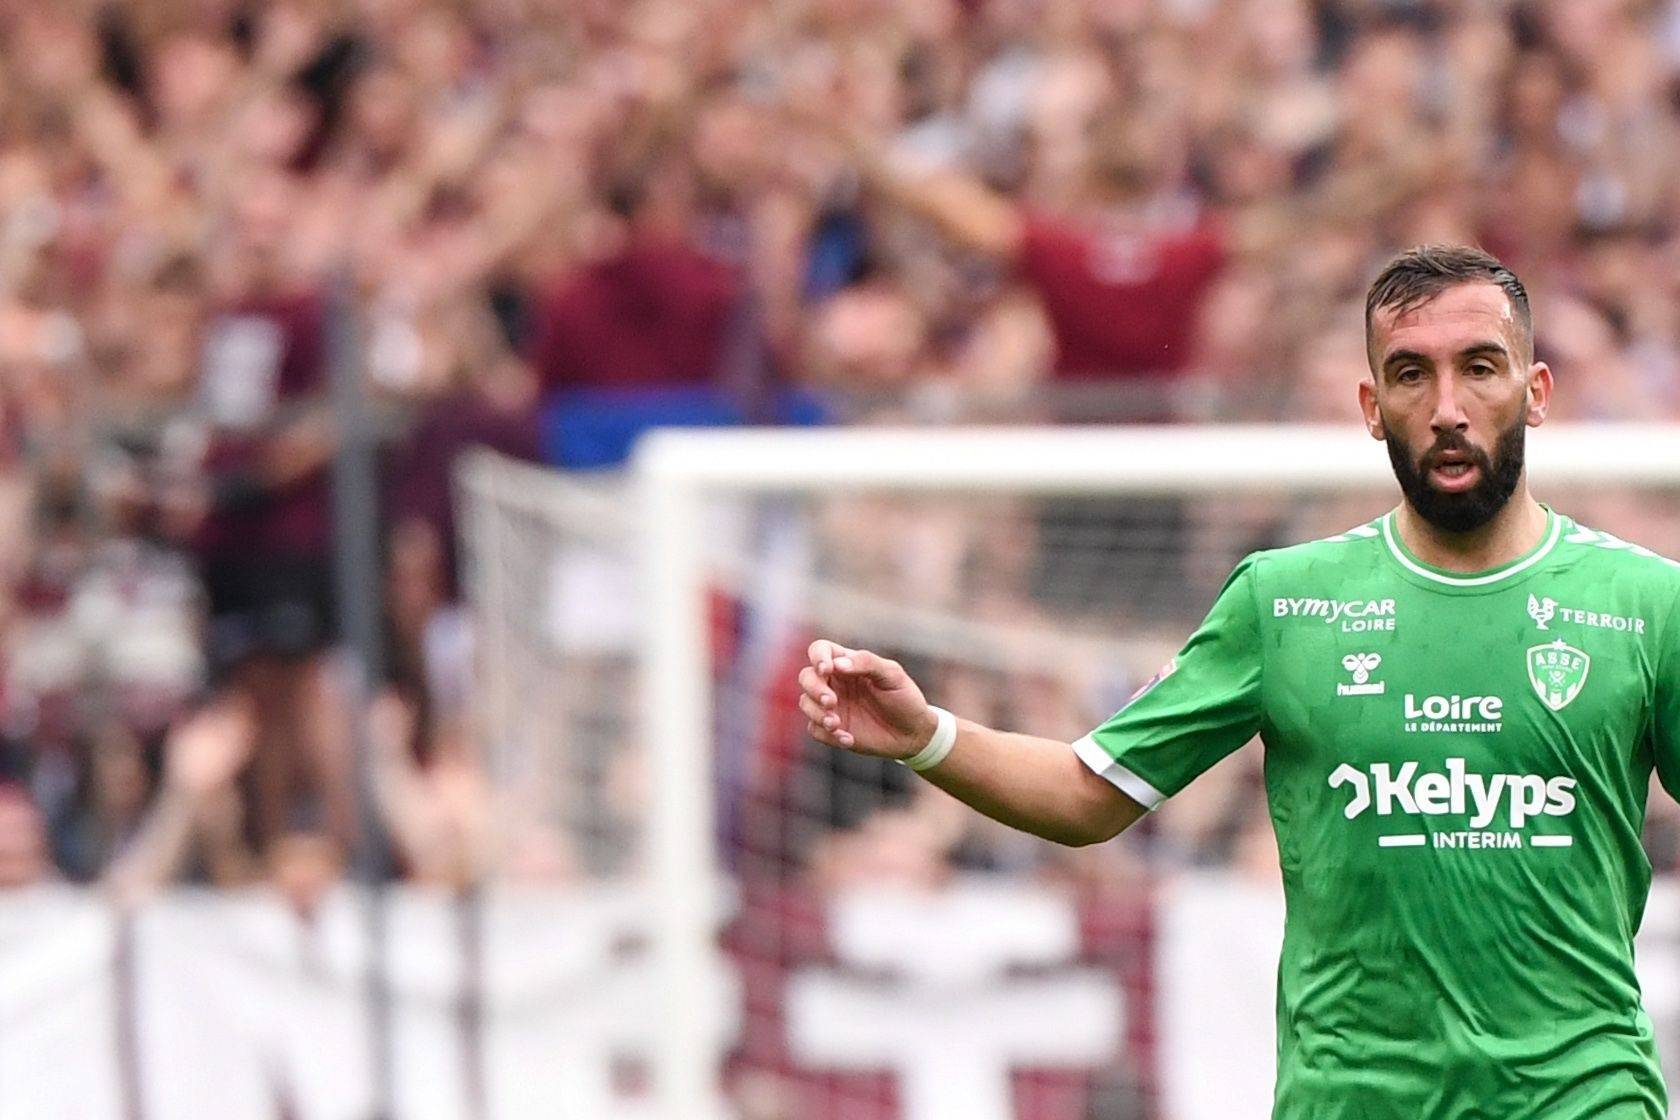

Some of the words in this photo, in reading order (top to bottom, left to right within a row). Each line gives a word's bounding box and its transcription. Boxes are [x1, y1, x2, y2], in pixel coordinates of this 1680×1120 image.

[1341, 618, 1396, 633] LOIRE
[1559, 607, 1645, 635] TERROIR
[1404, 693, 1503, 720] Loire
[1404, 721, 1418, 733] LE
[1420, 720, 1503, 733] DÉPARTEMENT
[1369, 757, 1577, 829] Kelyps
[1432, 831, 1522, 849] INTERIM
